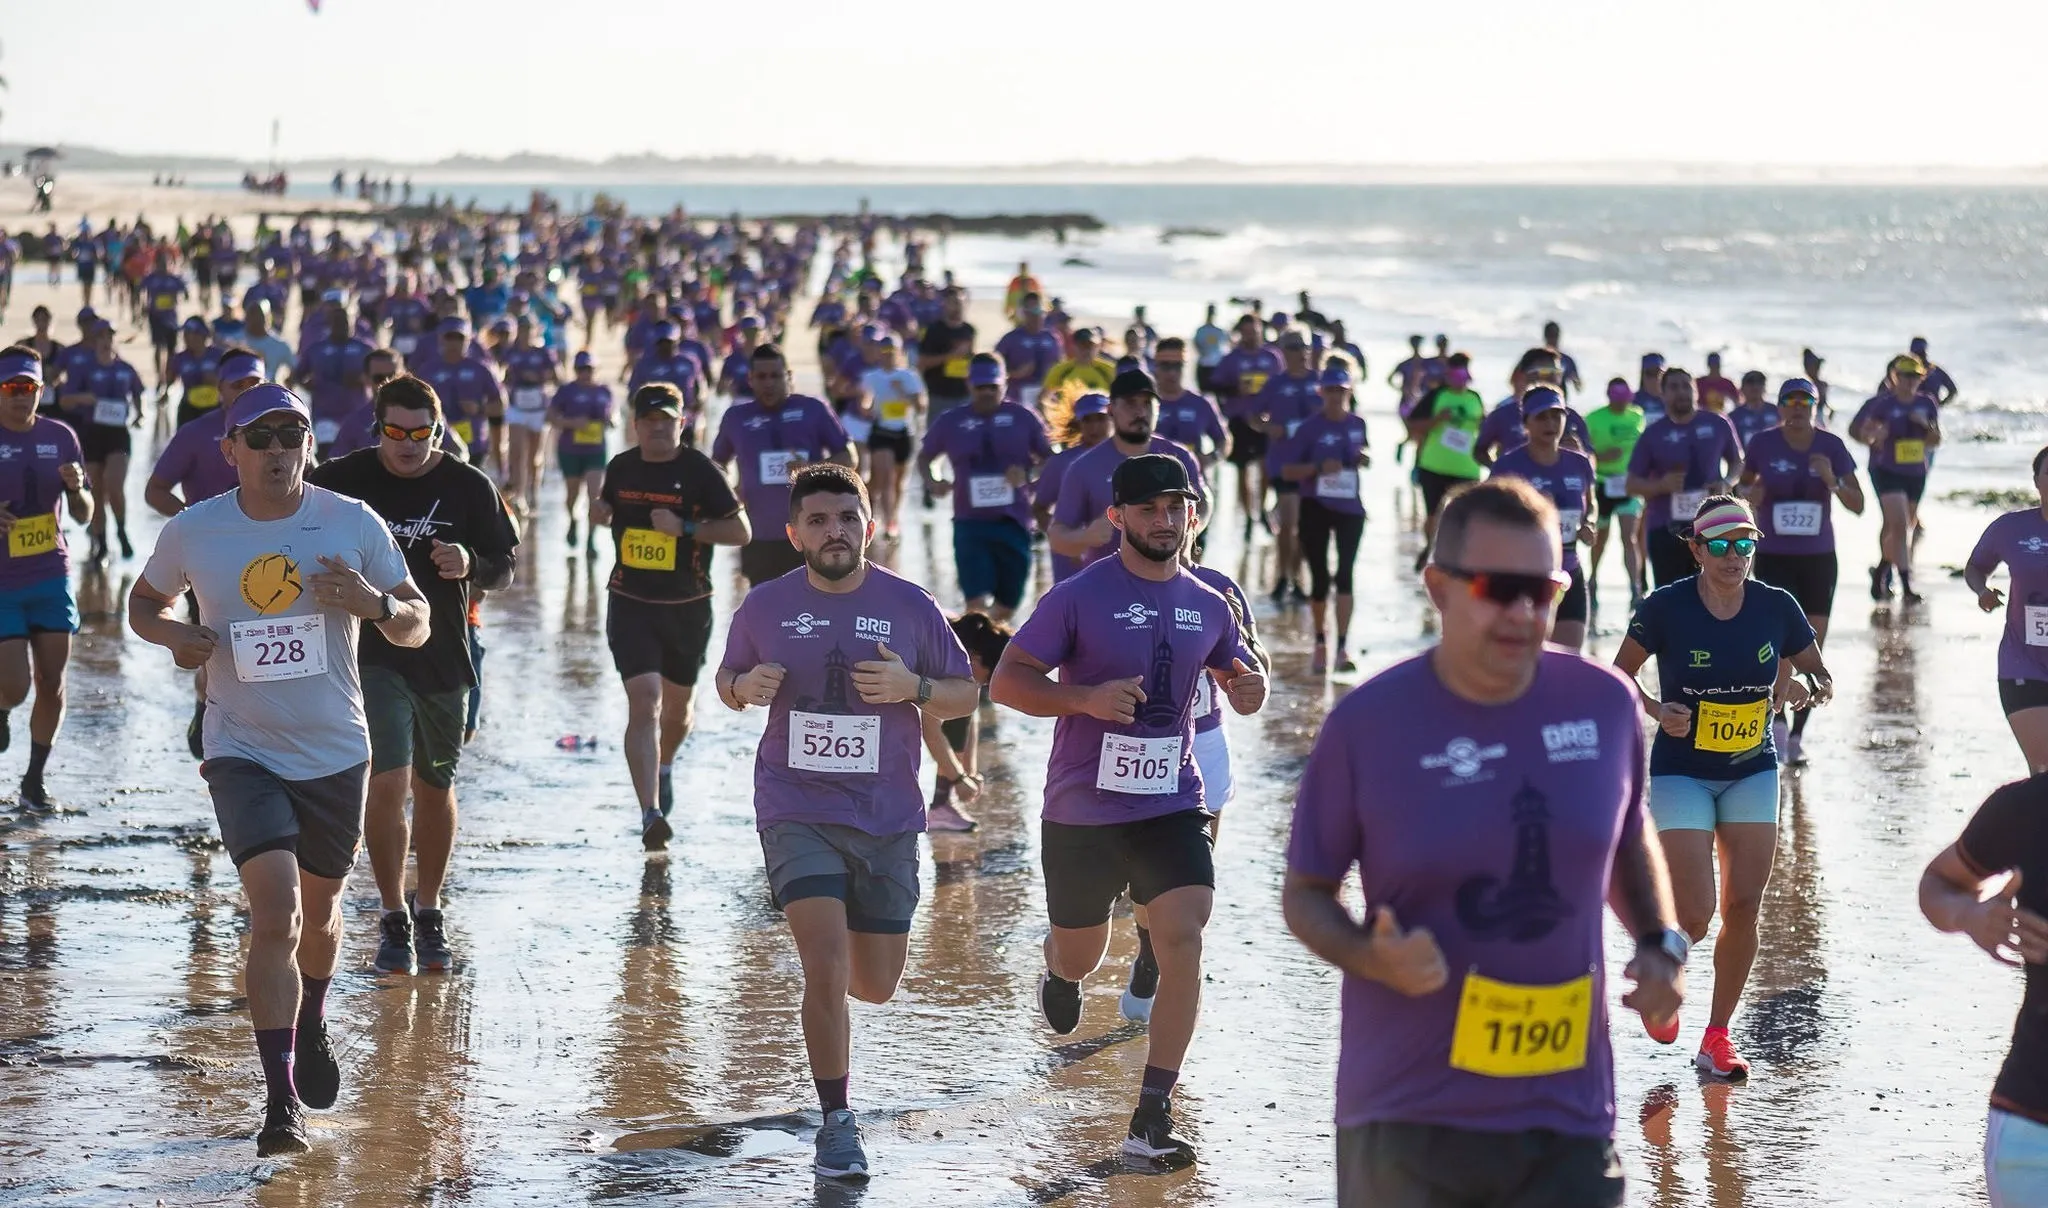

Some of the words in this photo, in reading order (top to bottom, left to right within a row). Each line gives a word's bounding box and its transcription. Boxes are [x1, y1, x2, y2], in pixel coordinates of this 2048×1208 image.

[387, 499, 453, 548] rowth
[1781, 514, 1814, 528] 5222
[18, 528, 52, 548] 1204
[628, 543, 666, 561] 1180
[856, 632, 891, 643] PARACURU
[254, 639, 305, 666] 228
[1709, 720, 1758, 740] 1048
[803, 733, 865, 758] 5263
[1114, 756, 1169, 779] 5105
[1484, 1018, 1572, 1056] 1190
